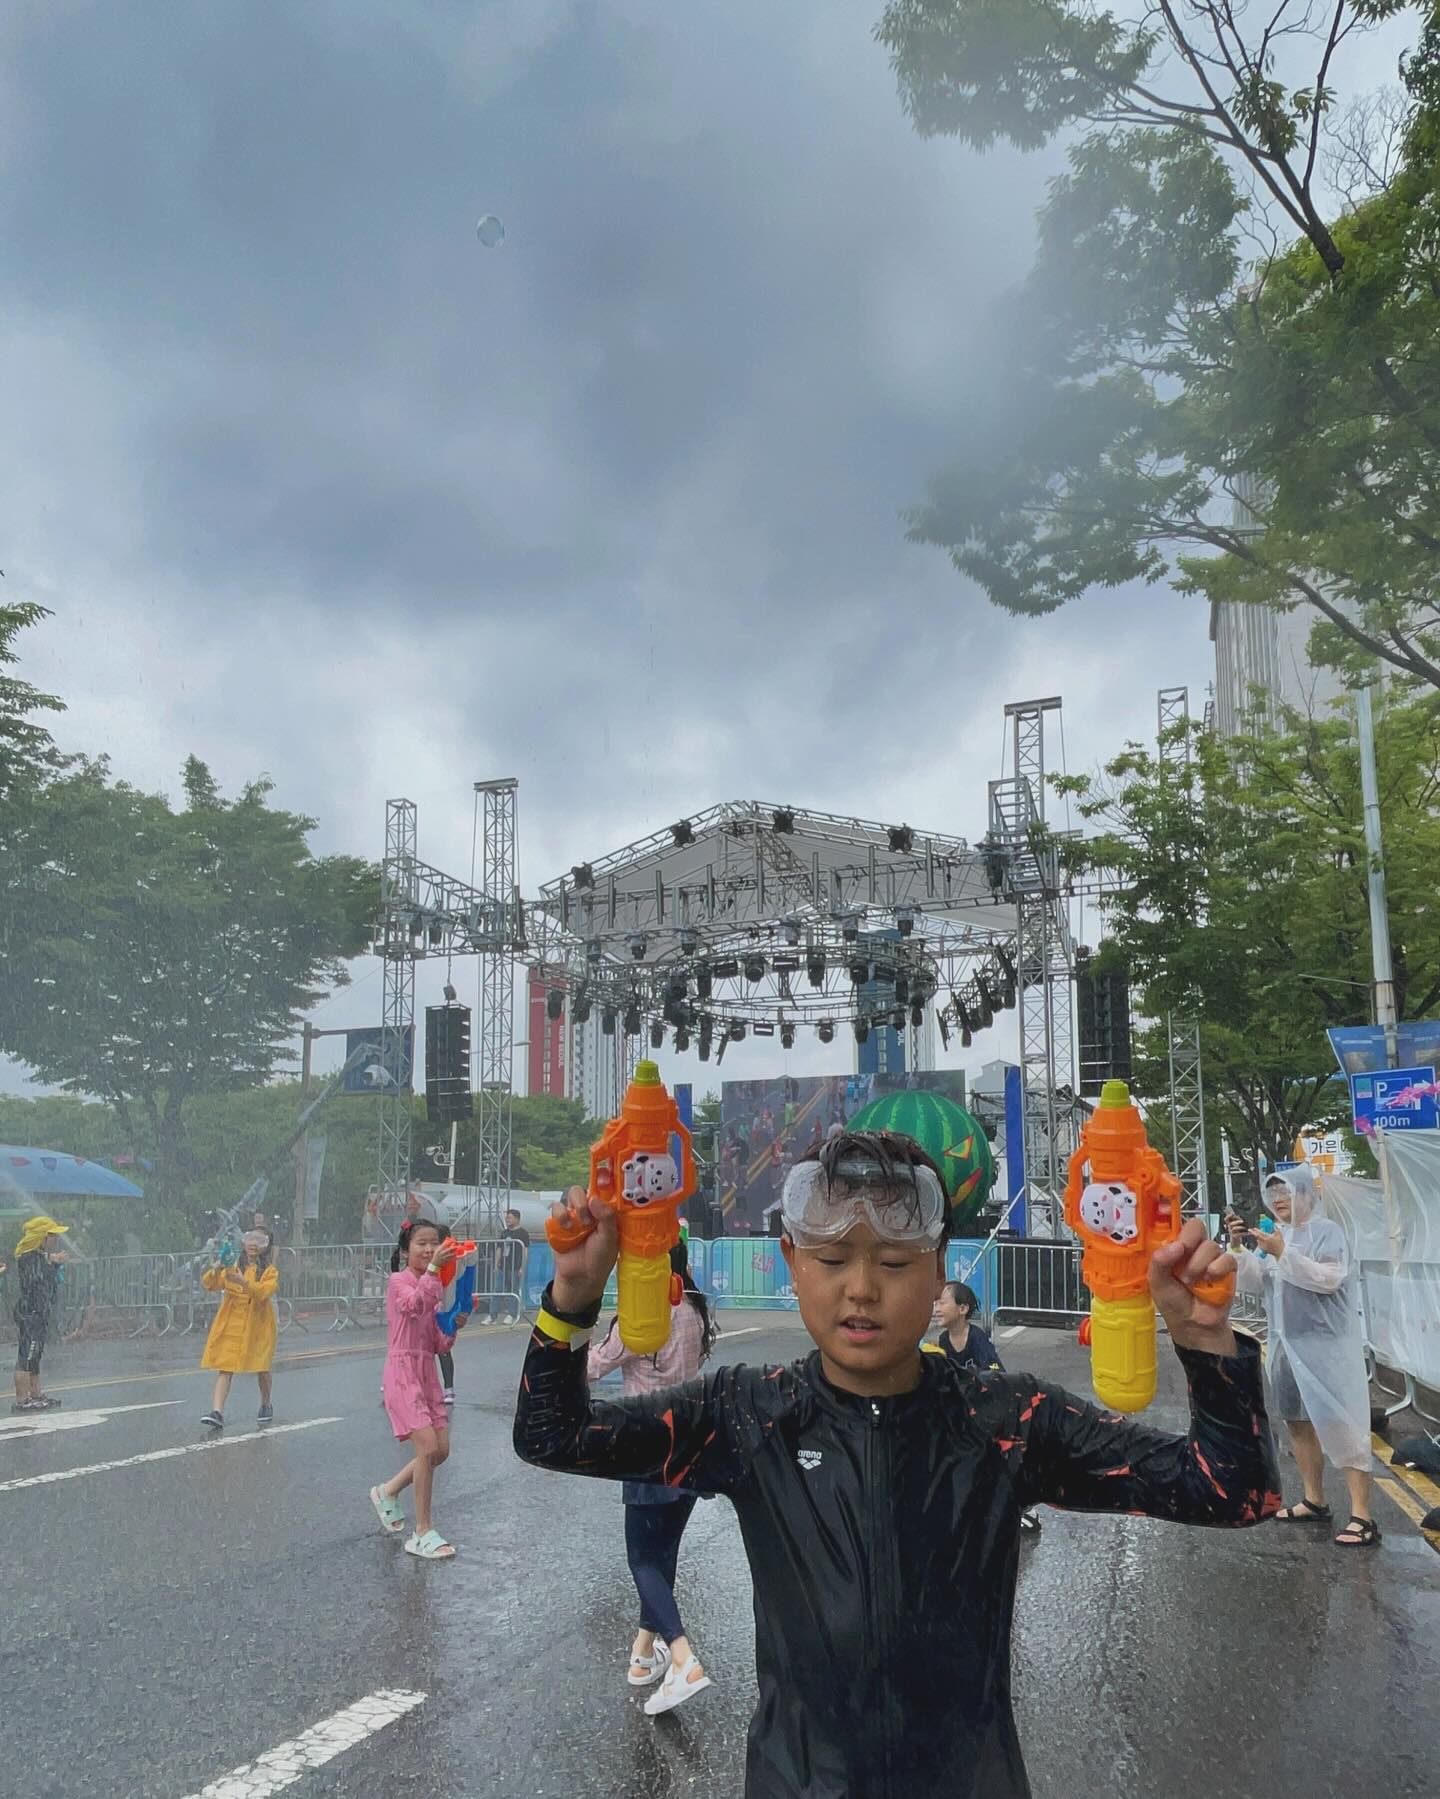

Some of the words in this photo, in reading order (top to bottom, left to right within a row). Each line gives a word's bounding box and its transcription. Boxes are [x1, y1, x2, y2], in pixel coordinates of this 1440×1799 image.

[1376, 1082, 1388, 1098] P
[1373, 1115, 1410, 1127] 100m
[797, 1449, 822, 1460] arena
